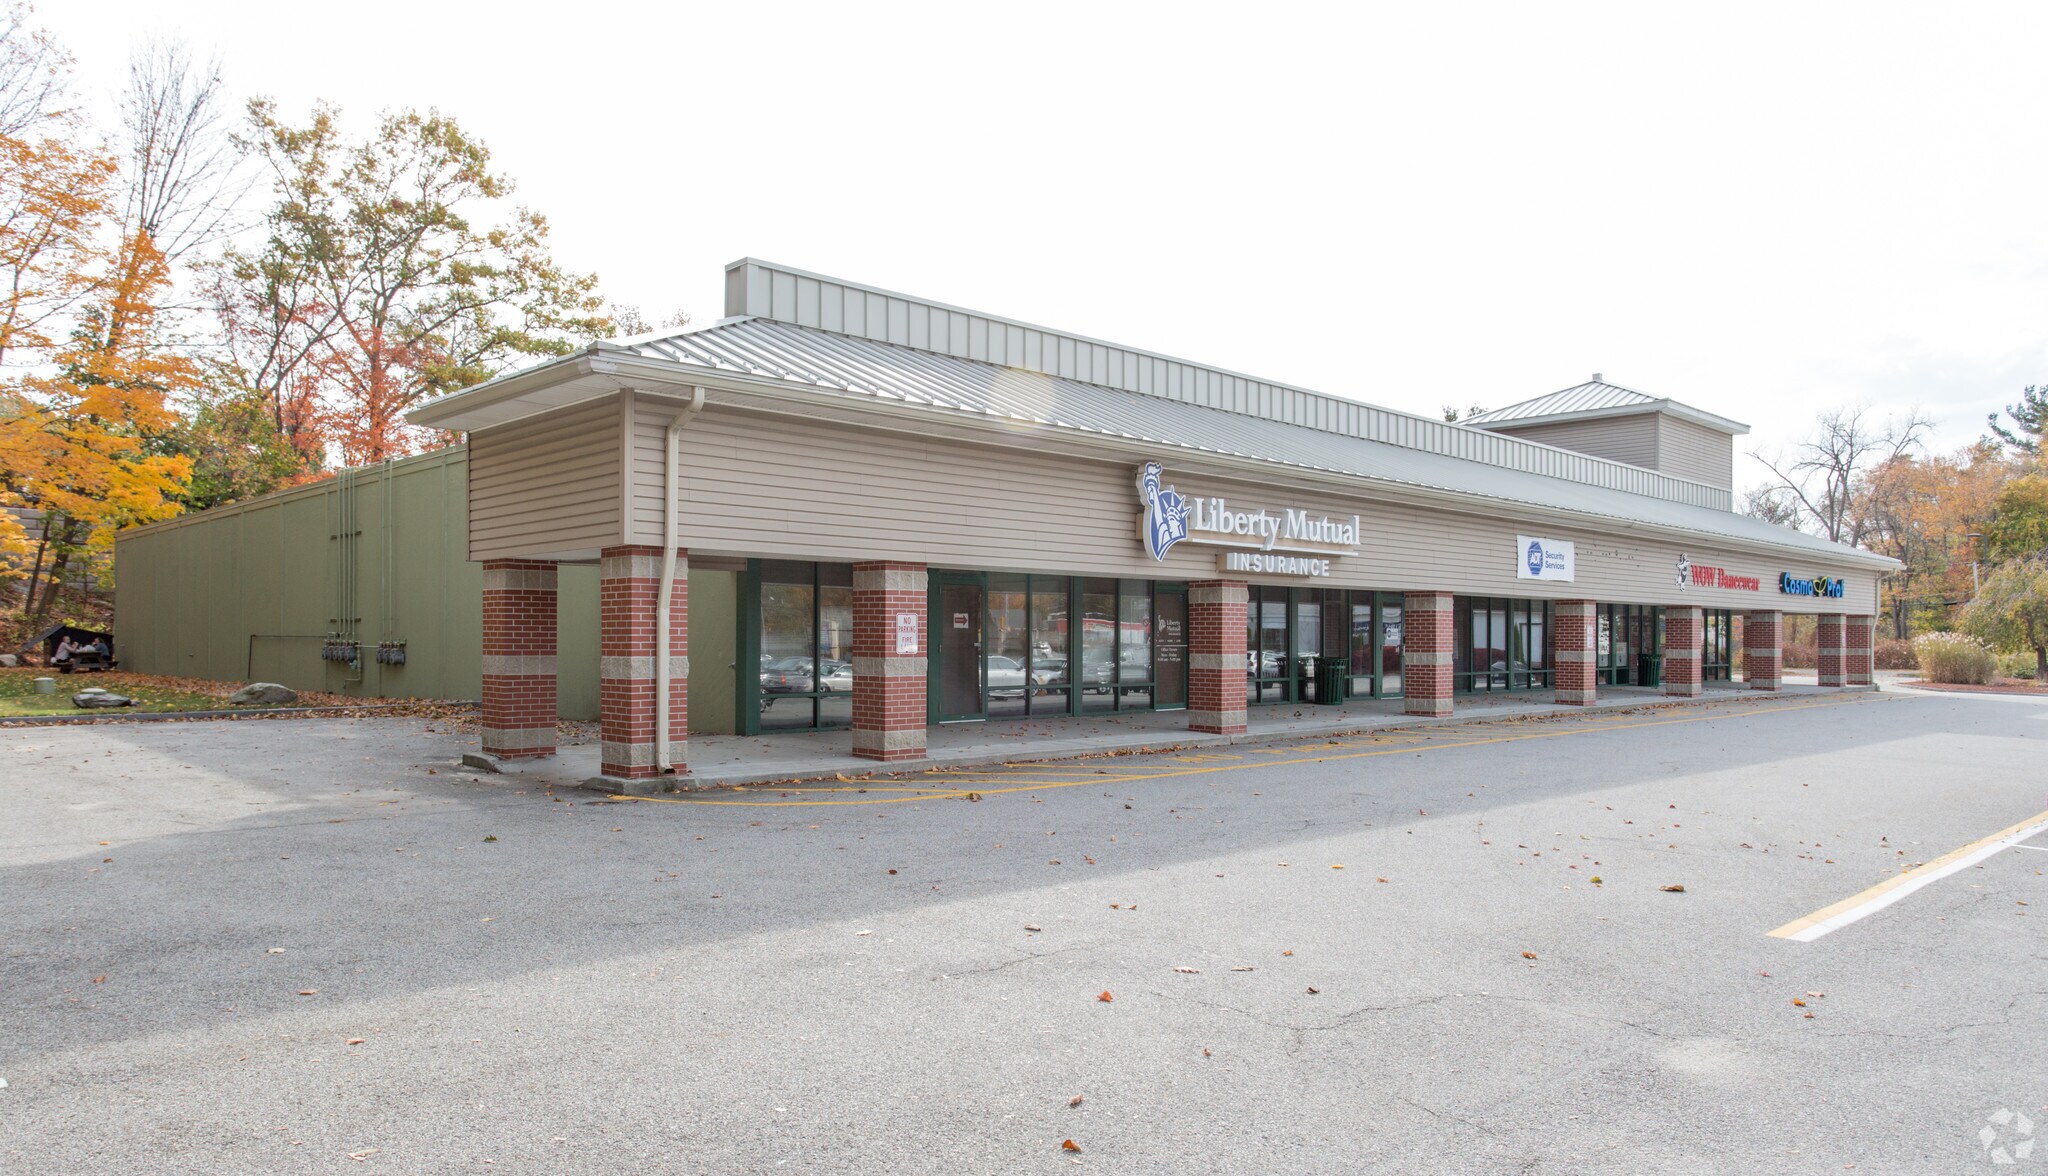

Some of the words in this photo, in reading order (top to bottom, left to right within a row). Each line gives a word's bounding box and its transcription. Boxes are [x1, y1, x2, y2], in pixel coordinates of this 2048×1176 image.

[1194, 497, 1282, 551] Liberty
[1285, 508, 1361, 545] Mutual
[1545, 551, 1564, 561] Security
[1232, 552, 1330, 577] INSURANCE
[1545, 561, 1565, 570] Services
[1690, 564, 1716, 587] WOW
[1783, 570, 1814, 596] Cosmo
[898, 625, 916, 633] PARKING
[903, 617, 912, 625] NO
